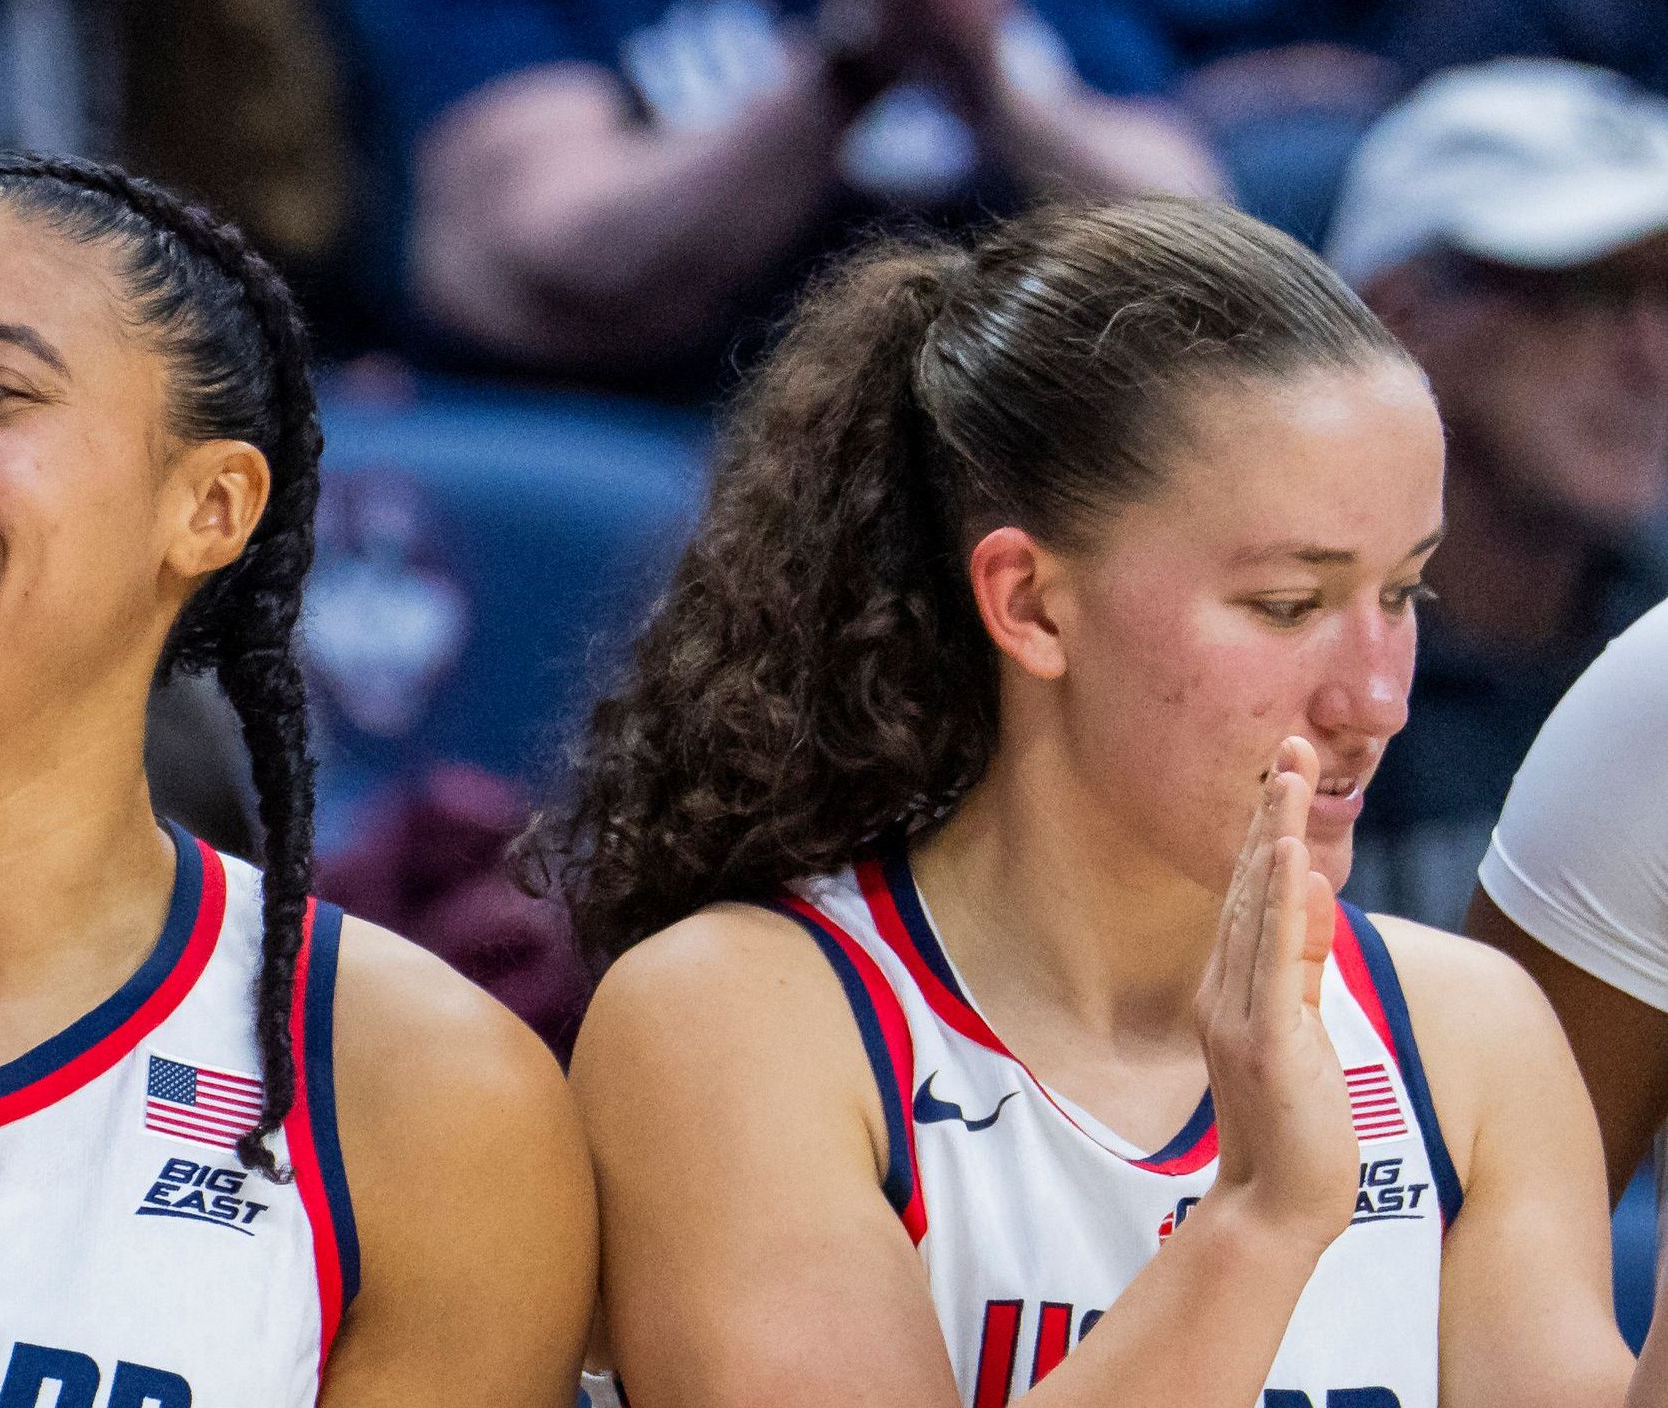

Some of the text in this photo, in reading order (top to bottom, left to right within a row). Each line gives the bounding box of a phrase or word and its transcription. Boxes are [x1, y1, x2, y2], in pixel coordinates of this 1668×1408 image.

[158, 1157, 248, 1195] BIG
[1359, 1158, 1403, 1188] IG
[143, 1181, 269, 1224] EAST
[1354, 1184, 1429, 1213] AST
